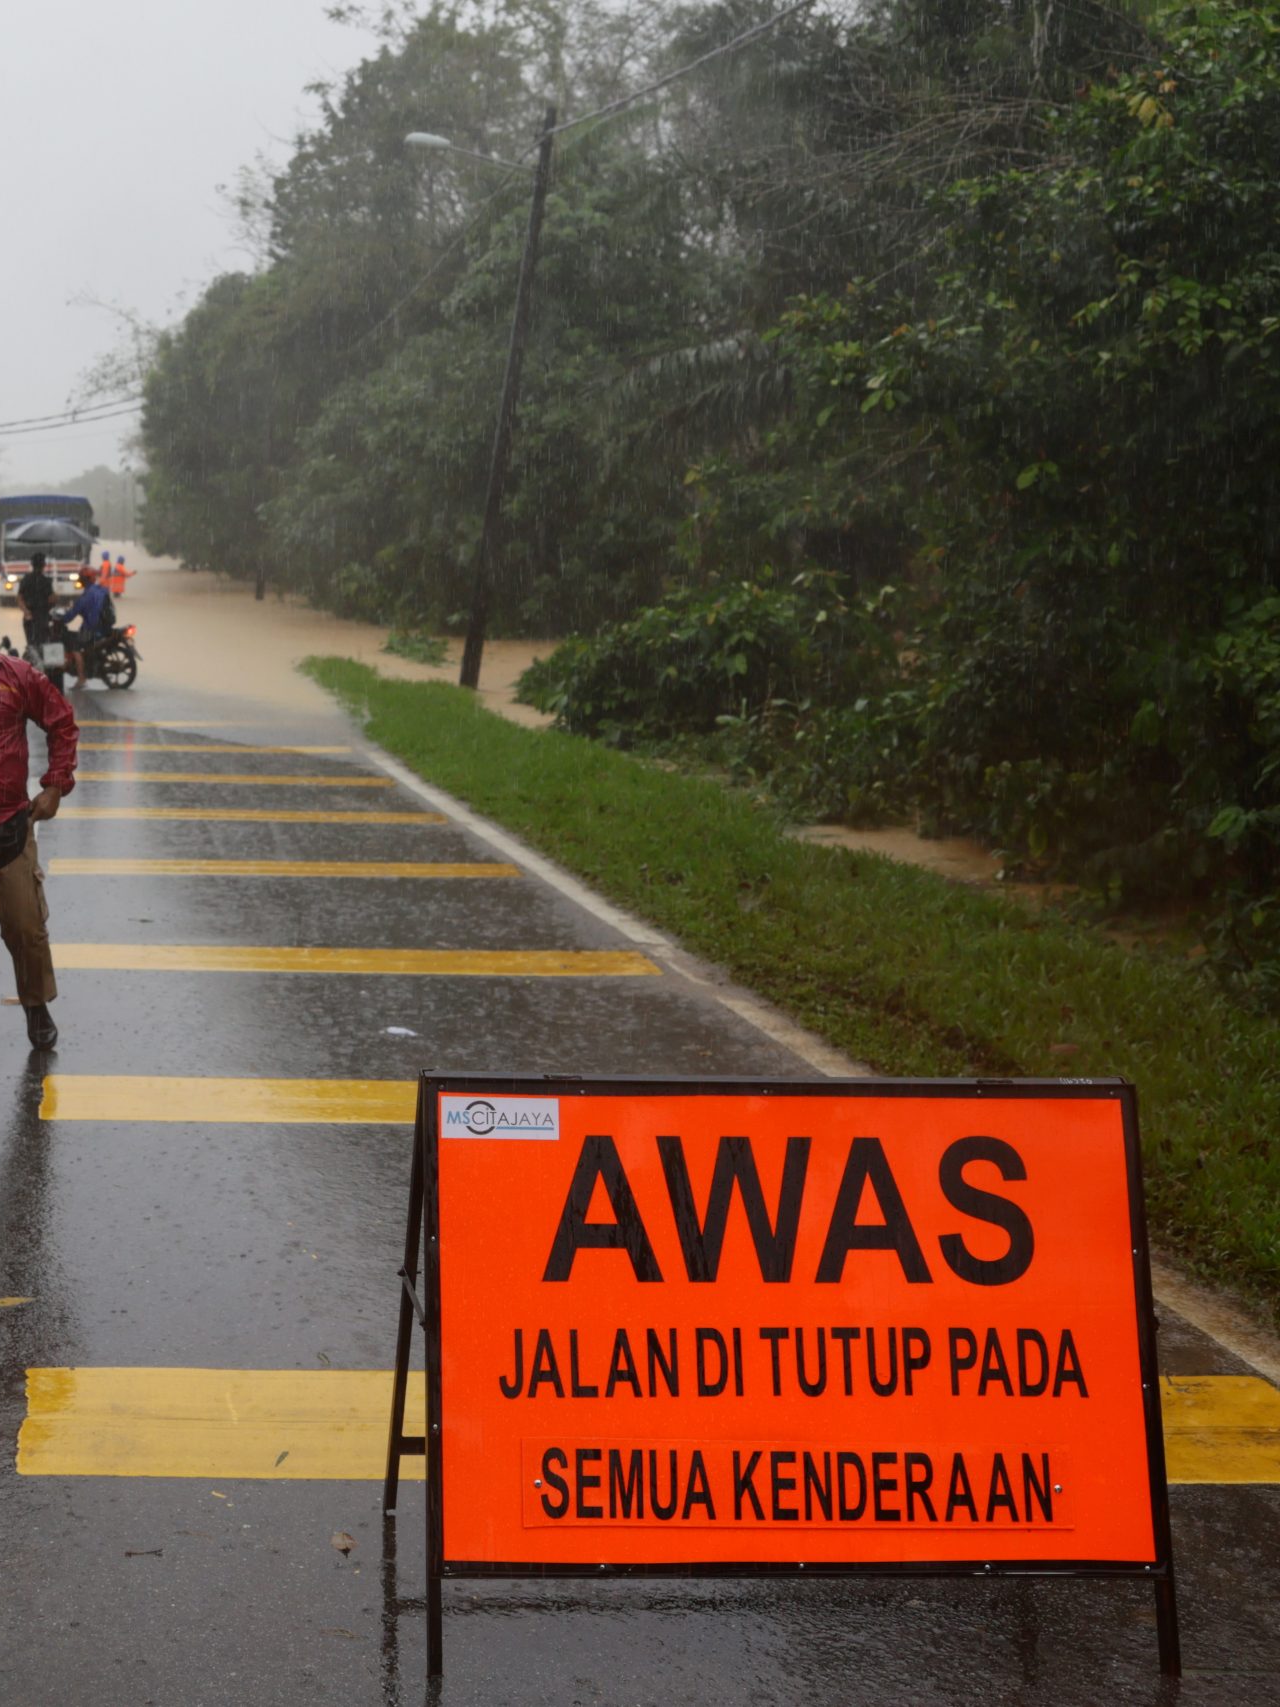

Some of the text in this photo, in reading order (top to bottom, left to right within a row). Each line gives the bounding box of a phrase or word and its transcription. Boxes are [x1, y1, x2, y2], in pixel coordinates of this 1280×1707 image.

[542, 1134, 1036, 1286] AWAS
[500, 1328, 1088, 1398] JALAN DI TUTUP PADA
[542, 1448, 1051, 1521] SEMUA KENDERAAN
